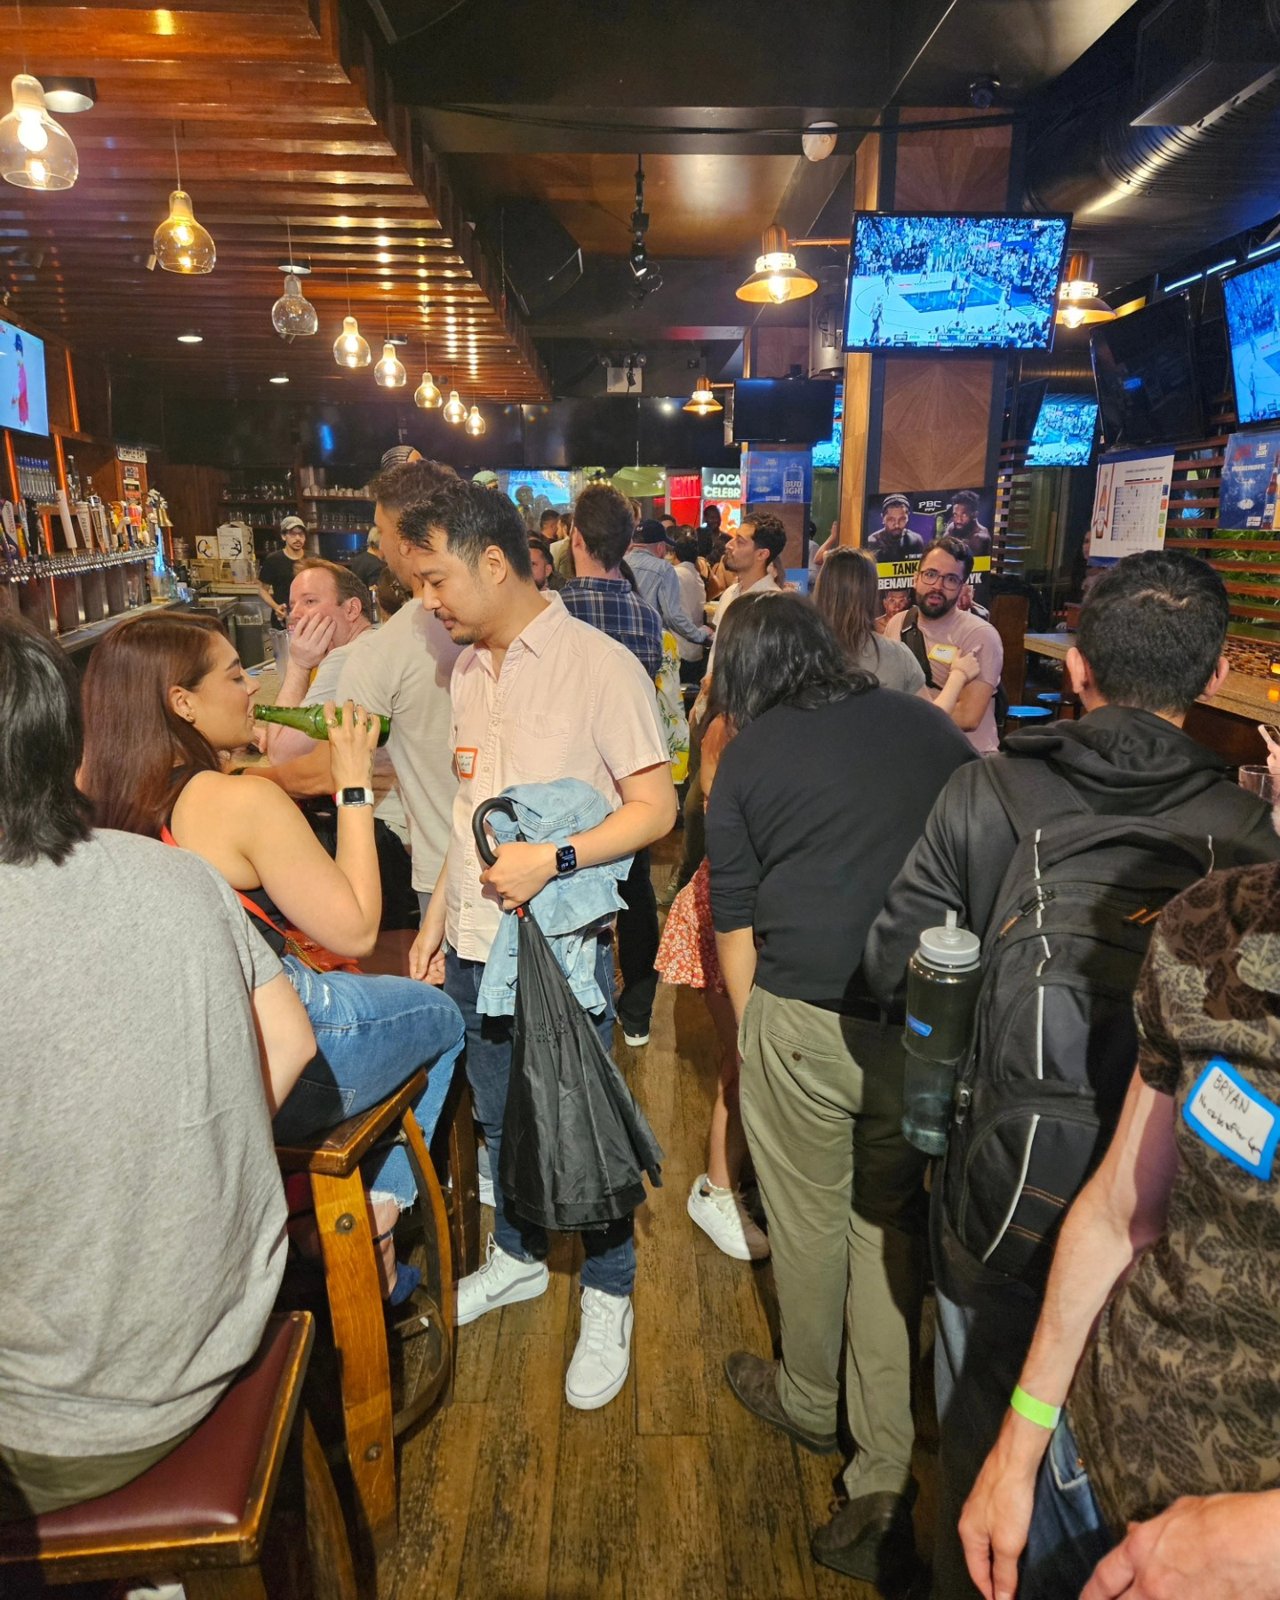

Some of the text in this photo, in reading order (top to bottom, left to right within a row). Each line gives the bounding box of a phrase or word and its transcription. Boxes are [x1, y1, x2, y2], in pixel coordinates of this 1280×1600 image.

[674, 475, 699, 496] EXIT
[712, 474, 740, 485] LOCA
[704, 486, 740, 498] CELEBR
[918, 500, 942, 509] PBC
[892, 562, 918, 575] TANK
[877, 576, 915, 590] BENAVID
[1213, 1074, 1250, 1114] BRYAN
